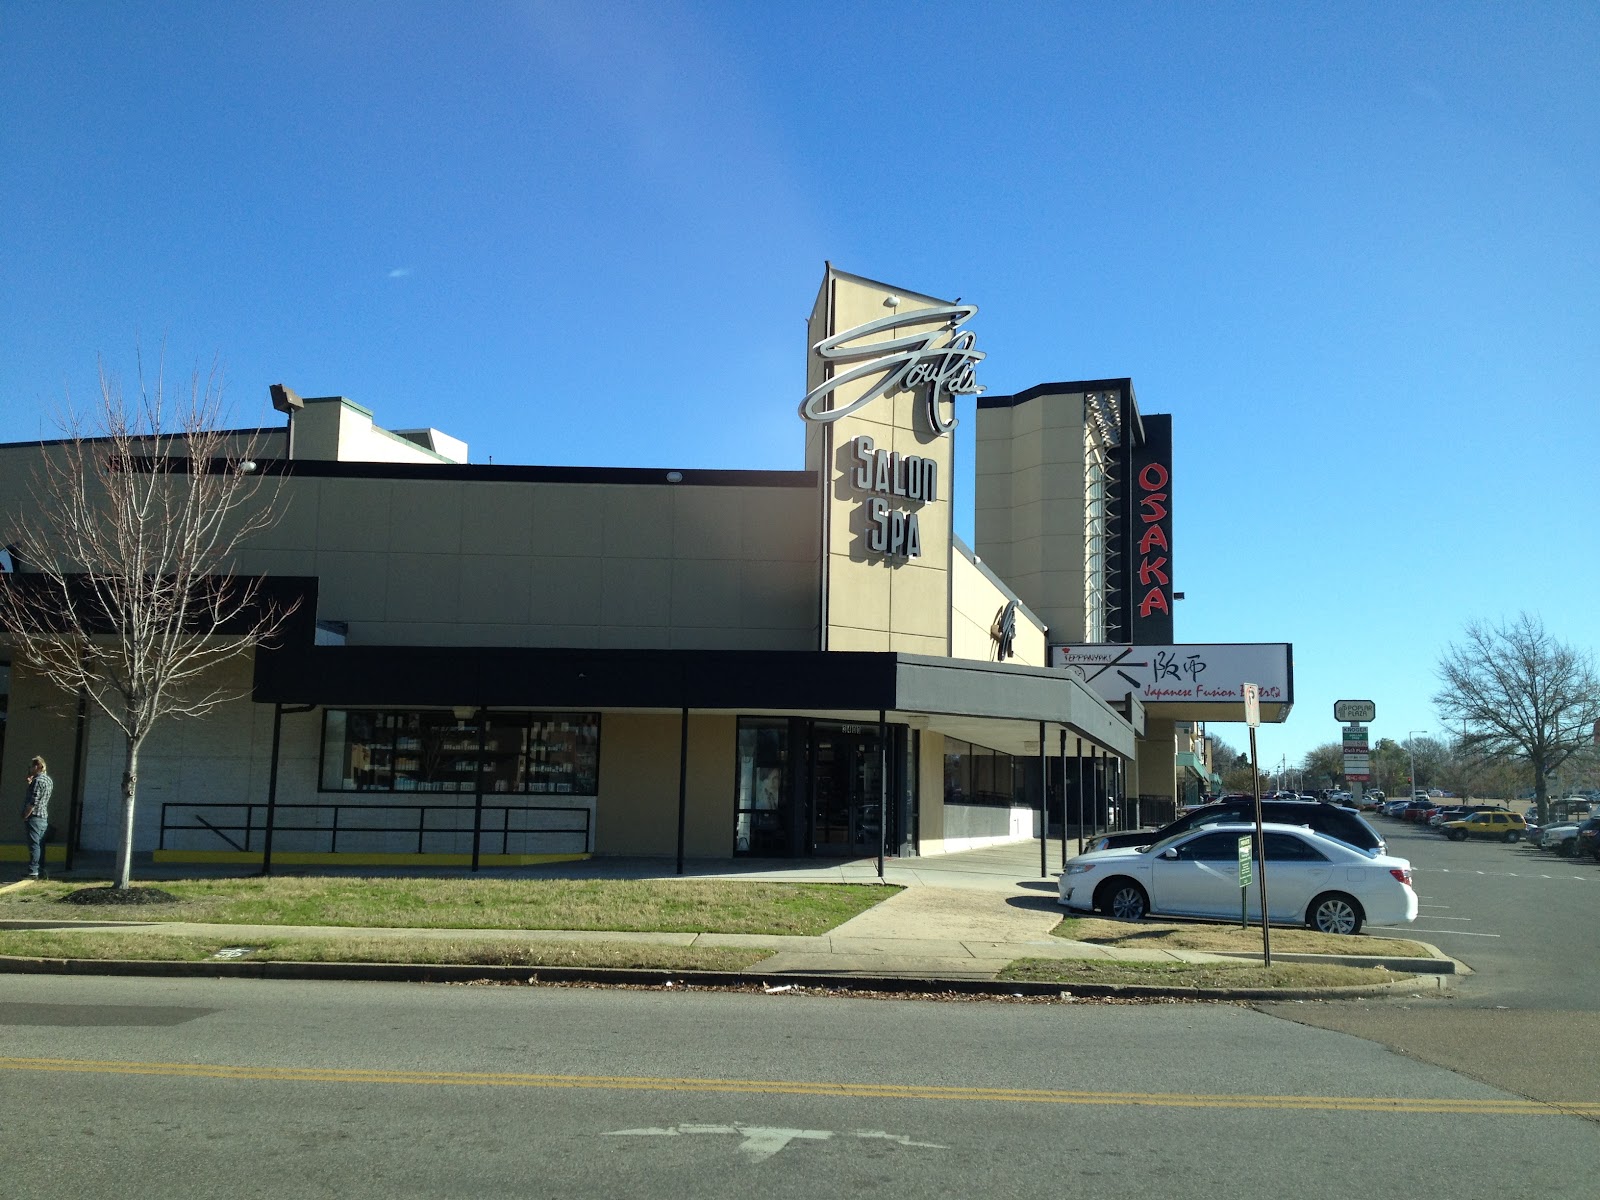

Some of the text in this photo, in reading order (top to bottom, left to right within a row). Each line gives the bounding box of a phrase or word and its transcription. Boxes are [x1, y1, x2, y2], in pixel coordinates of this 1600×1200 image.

[866, 497, 922, 559] SPA
[1137, 462, 1170, 618] OSAKA
[1144, 684, 1192, 700] Japanese
[1196, 684, 1236, 698] Fusion
[1347, 704, 1373, 712] POPLAR
